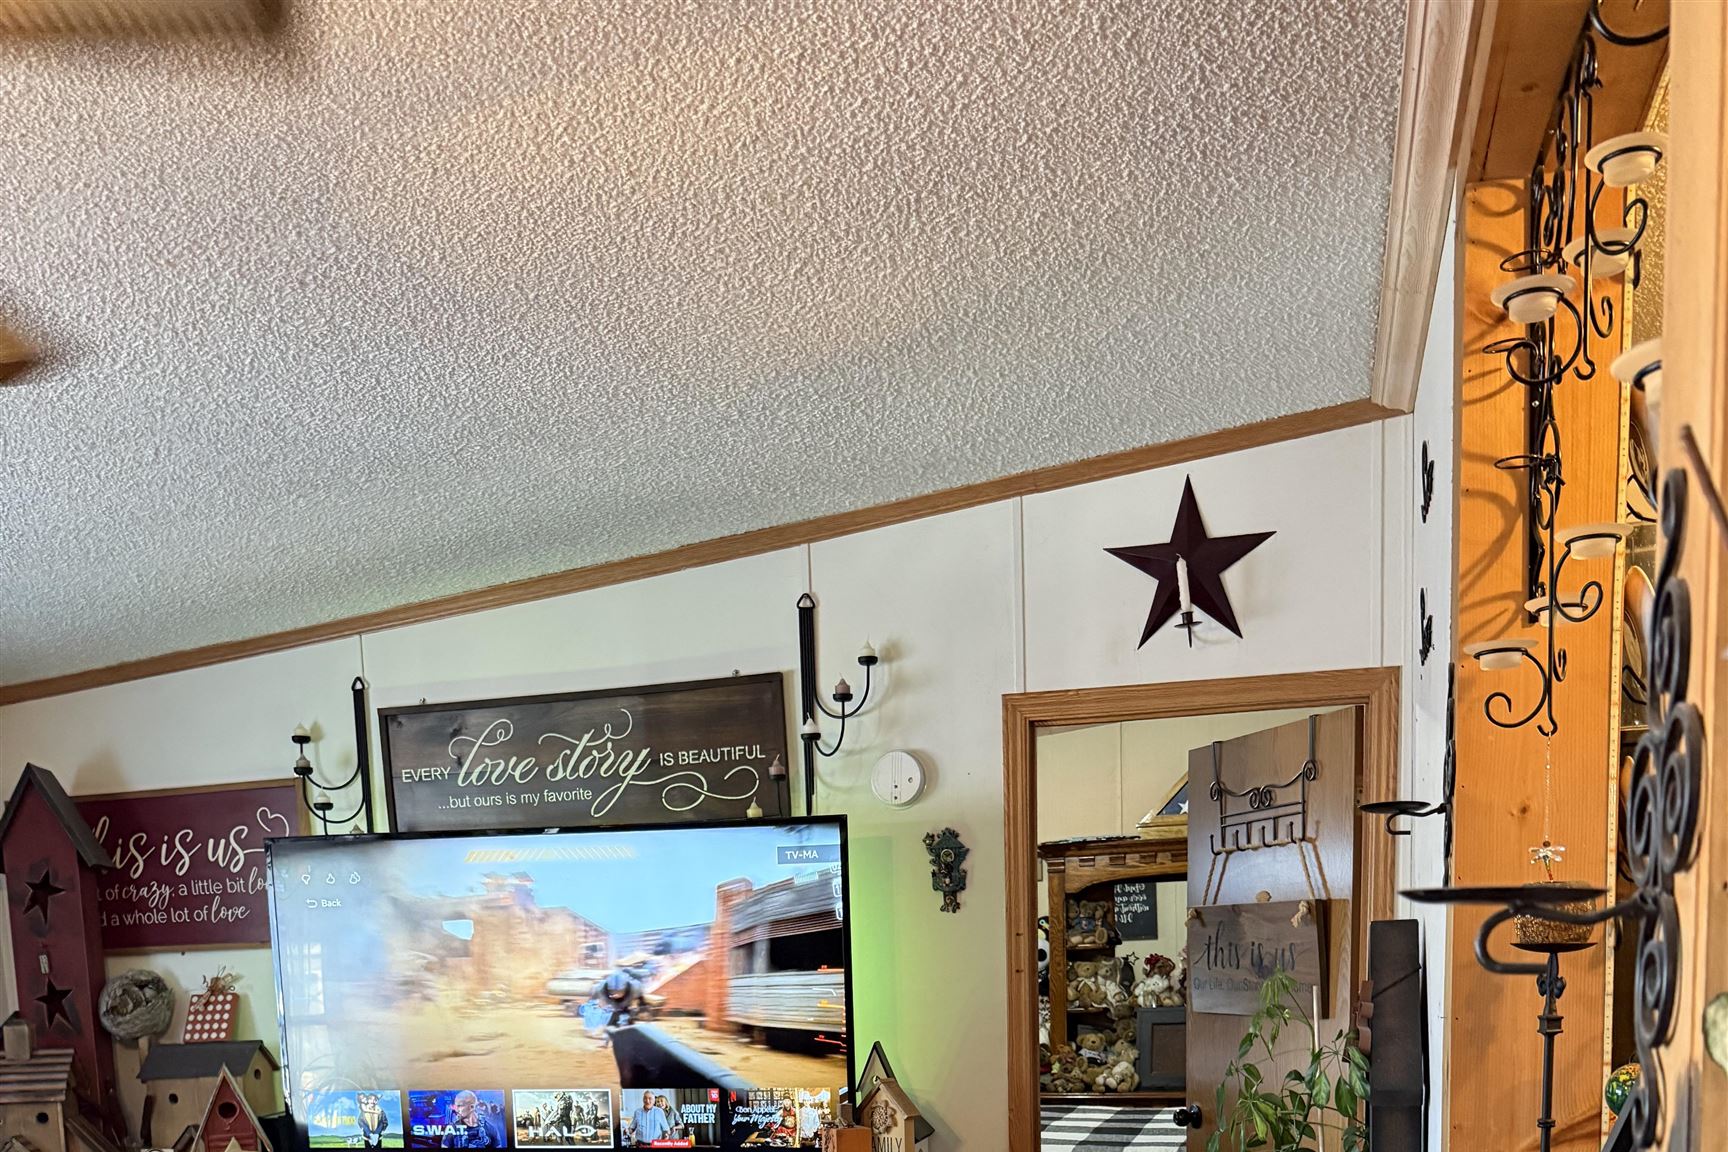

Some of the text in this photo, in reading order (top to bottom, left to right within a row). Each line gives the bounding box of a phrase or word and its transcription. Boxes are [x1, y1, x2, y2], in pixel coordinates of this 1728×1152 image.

[402, 766, 452, 783] EVERY
[449, 719, 538, 787] love
[659, 752, 673, 766] IS
[678, 744, 766, 766] BEAUTIFUL
[438, 787, 593, 810] ...but ours is my favorite
[161, 829, 201, 876] is
[207, 825, 252, 873] us
[785, 849, 819, 860] TV-MA
[105, 884, 120, 900] of
[178, 884, 188, 896] a
[191, 879, 223, 896] little
[226, 877, 246, 894] bit
[111, 915, 120, 926] a
[122, 909, 167, 926] whole
[171, 907, 190, 923] lot
[193, 906, 209, 921] of
[211, 895, 250, 924] love
[321, 898, 342, 908] Back
[1194, 920, 1296, 972] this is us
[681, 1104, 717, 1113] ABOUT MY
[683, 1114, 715, 1124] FATHER
[732, 1113, 784, 1129] Your Majesty
[411, 1125, 468, 1136] S.W.A.T.
[528, 1126, 598, 1137] HALO
